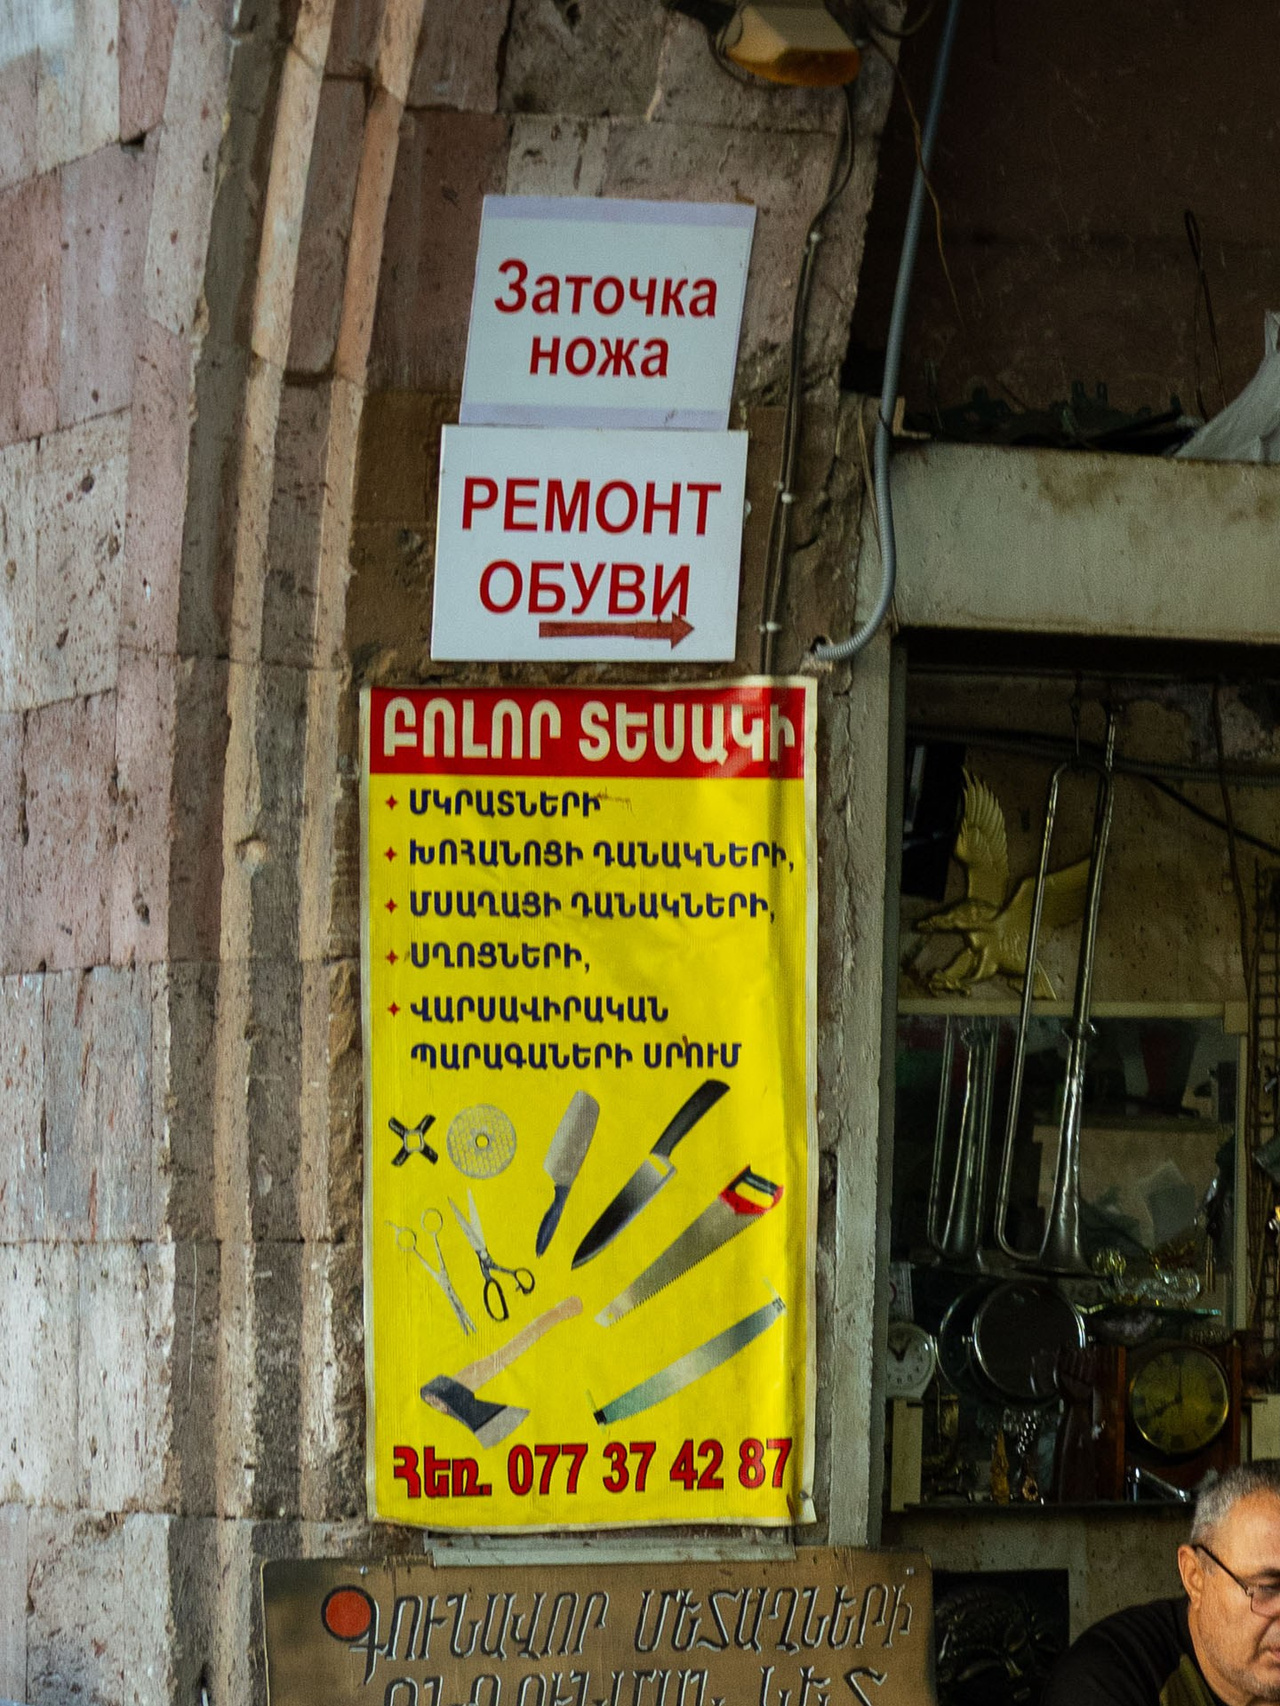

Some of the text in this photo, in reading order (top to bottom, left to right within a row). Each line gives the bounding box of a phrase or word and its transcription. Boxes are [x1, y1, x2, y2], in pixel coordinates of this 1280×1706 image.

[494, 258, 718, 318] Заточка
[529, 336, 669, 377] ножа
[462, 476, 721, 536] РЕМОНТ
[479, 558, 691, 617] ОБУВИ
[384, 697, 795, 766] ԲՈԼՈՐ ՏԵՍԱԿԻ
[410, 788, 600, 818] ՄԿՐԱՏՆԵՐԻ
[410, 839, 794, 872] ԽՈՀԱՆՈՑԻ ԴԱՆԱԿՆԵՐԻ,
[410, 890, 775, 923] ՄՍԱՂԱՑԻ ԴԱՆԱԿՆԵՐԻ,
[411, 942, 590, 973] ՍՂՈՑՆԵՐԻ,
[410, 996, 668, 1023] ՎԱՐՍԱՎԻՐԱԿԱՆ
[411, 1042, 742, 1070] ՊԱՐԱԳԱՆԵՐԻ ՍՐՈՒՄ
[393, 1438, 792, 1498] Հեռ. 077 37 42 87
[321, 1583, 914, 1685] ԳՈՒՆԱՎՈՐ ՄԵՏԱՂՆԵՐԻ
